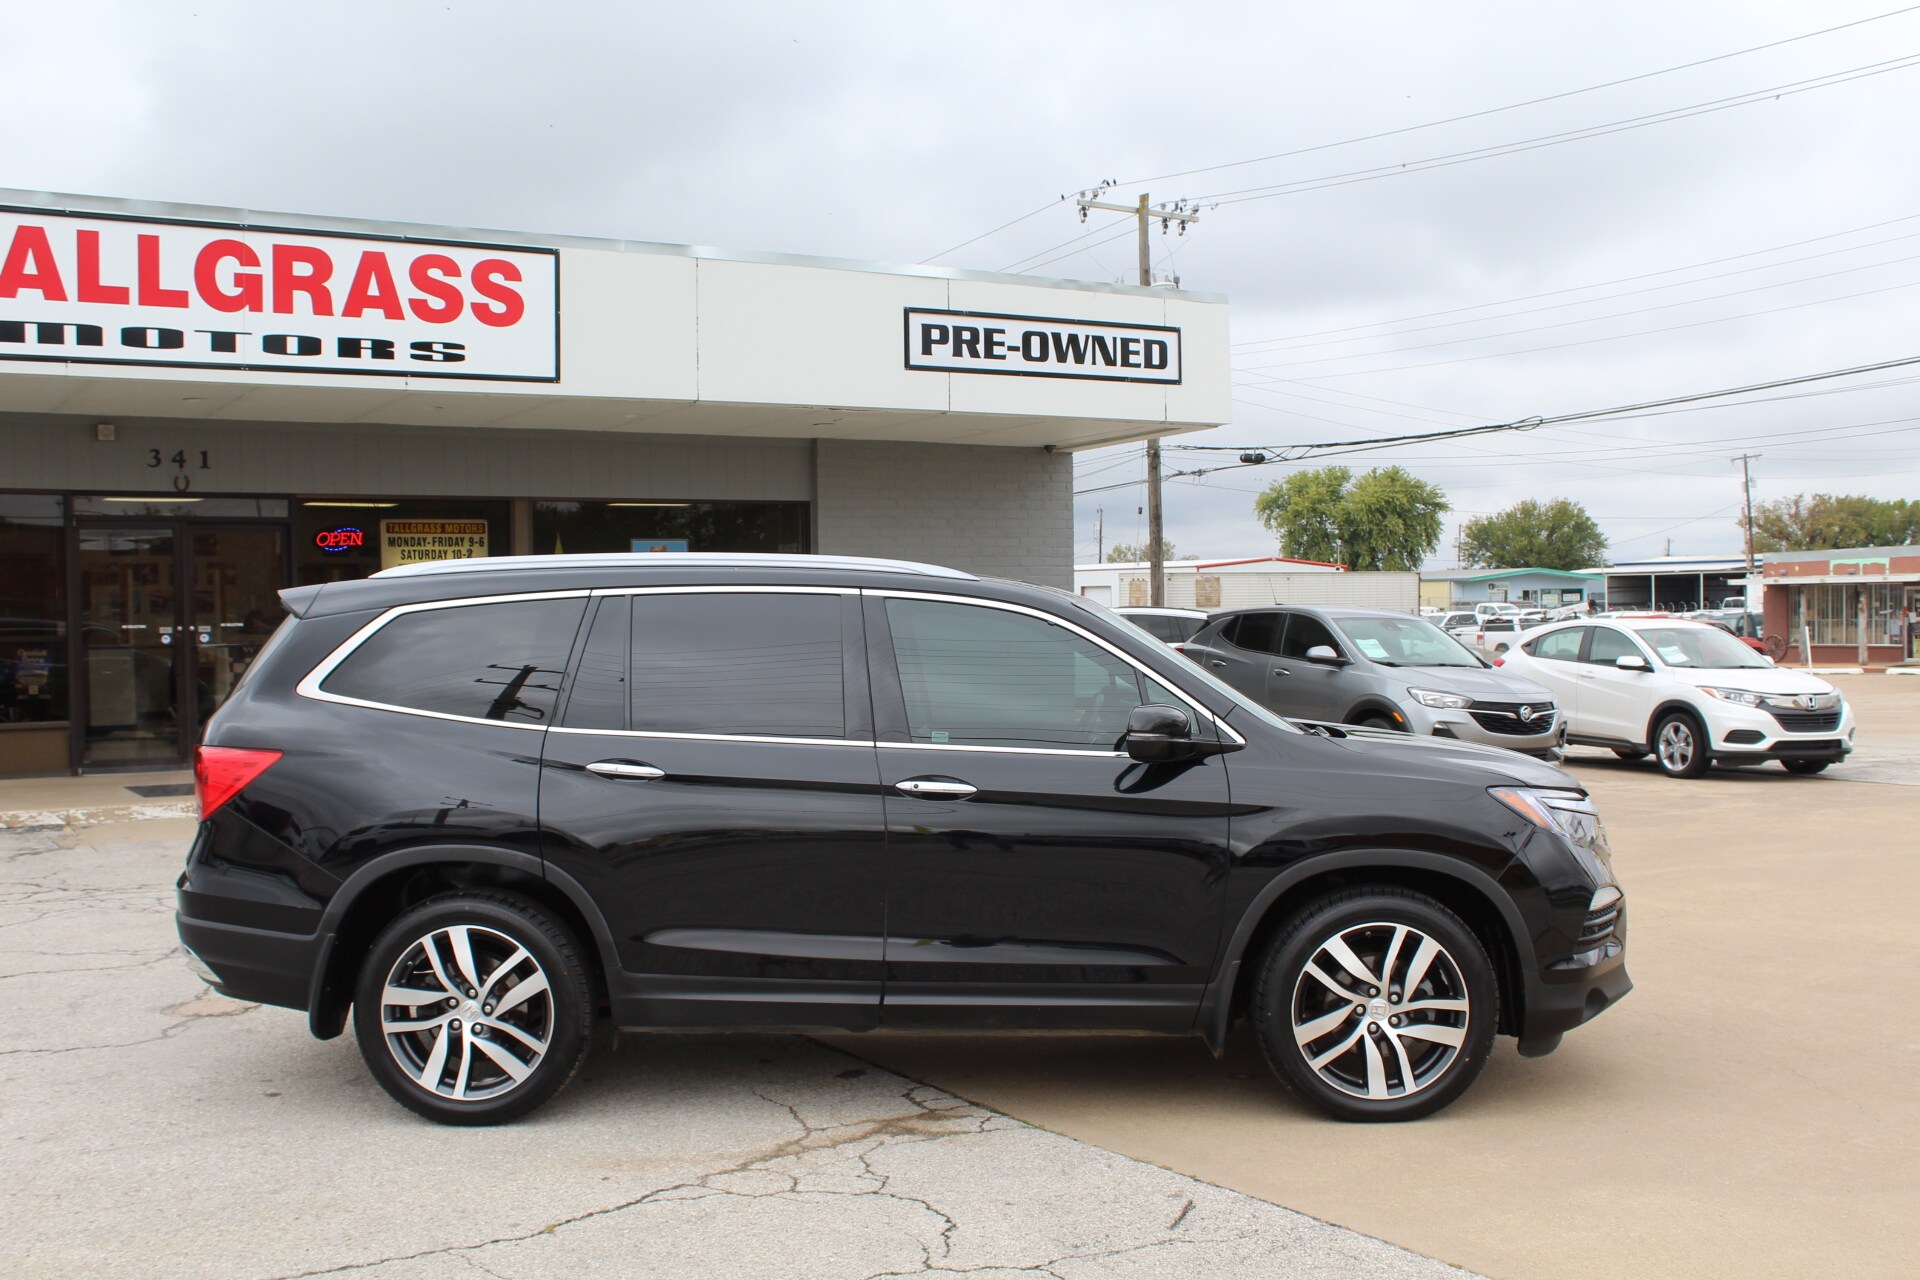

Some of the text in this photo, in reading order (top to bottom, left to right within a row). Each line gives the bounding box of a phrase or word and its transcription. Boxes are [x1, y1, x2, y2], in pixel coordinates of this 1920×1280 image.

[0, 320, 466, 363] MOTORS
[921, 323, 1168, 370] PRE-OWNED
[147, 448, 211, 470] 341
[388, 523, 484, 533] TALLGRASS MOTORS
[316, 531, 364, 546] OPEN
[388, 536, 485, 547] MONDAY-FRIDAY 9-6
[400, 549, 473, 560] SATURDAY 10-2
